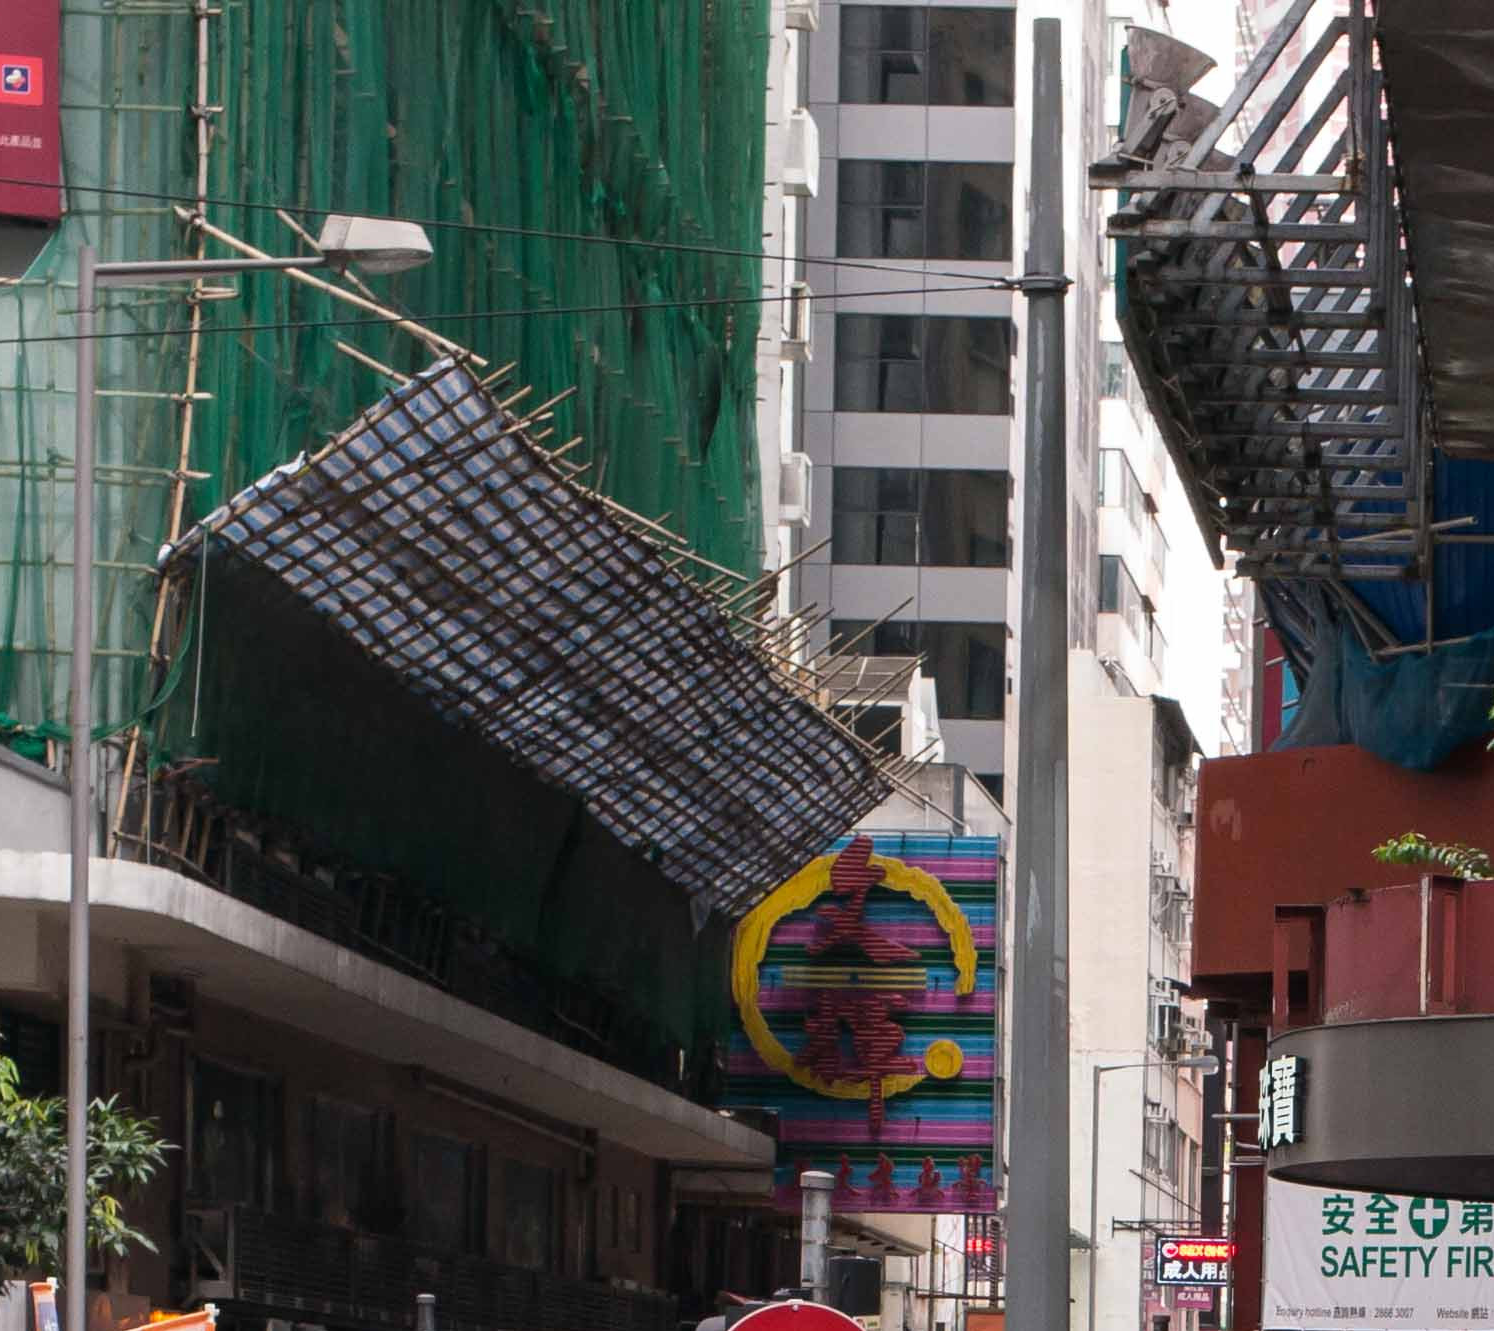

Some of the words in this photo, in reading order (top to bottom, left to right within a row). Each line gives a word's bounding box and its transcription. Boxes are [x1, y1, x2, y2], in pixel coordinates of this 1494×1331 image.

[1322, 1194, 1399, 1236] 安全
[1179, 1245, 1204, 1258] SEX
[1321, 1245, 1438, 1278] SAFETY
[1436, 1306, 1469, 1319] Website
